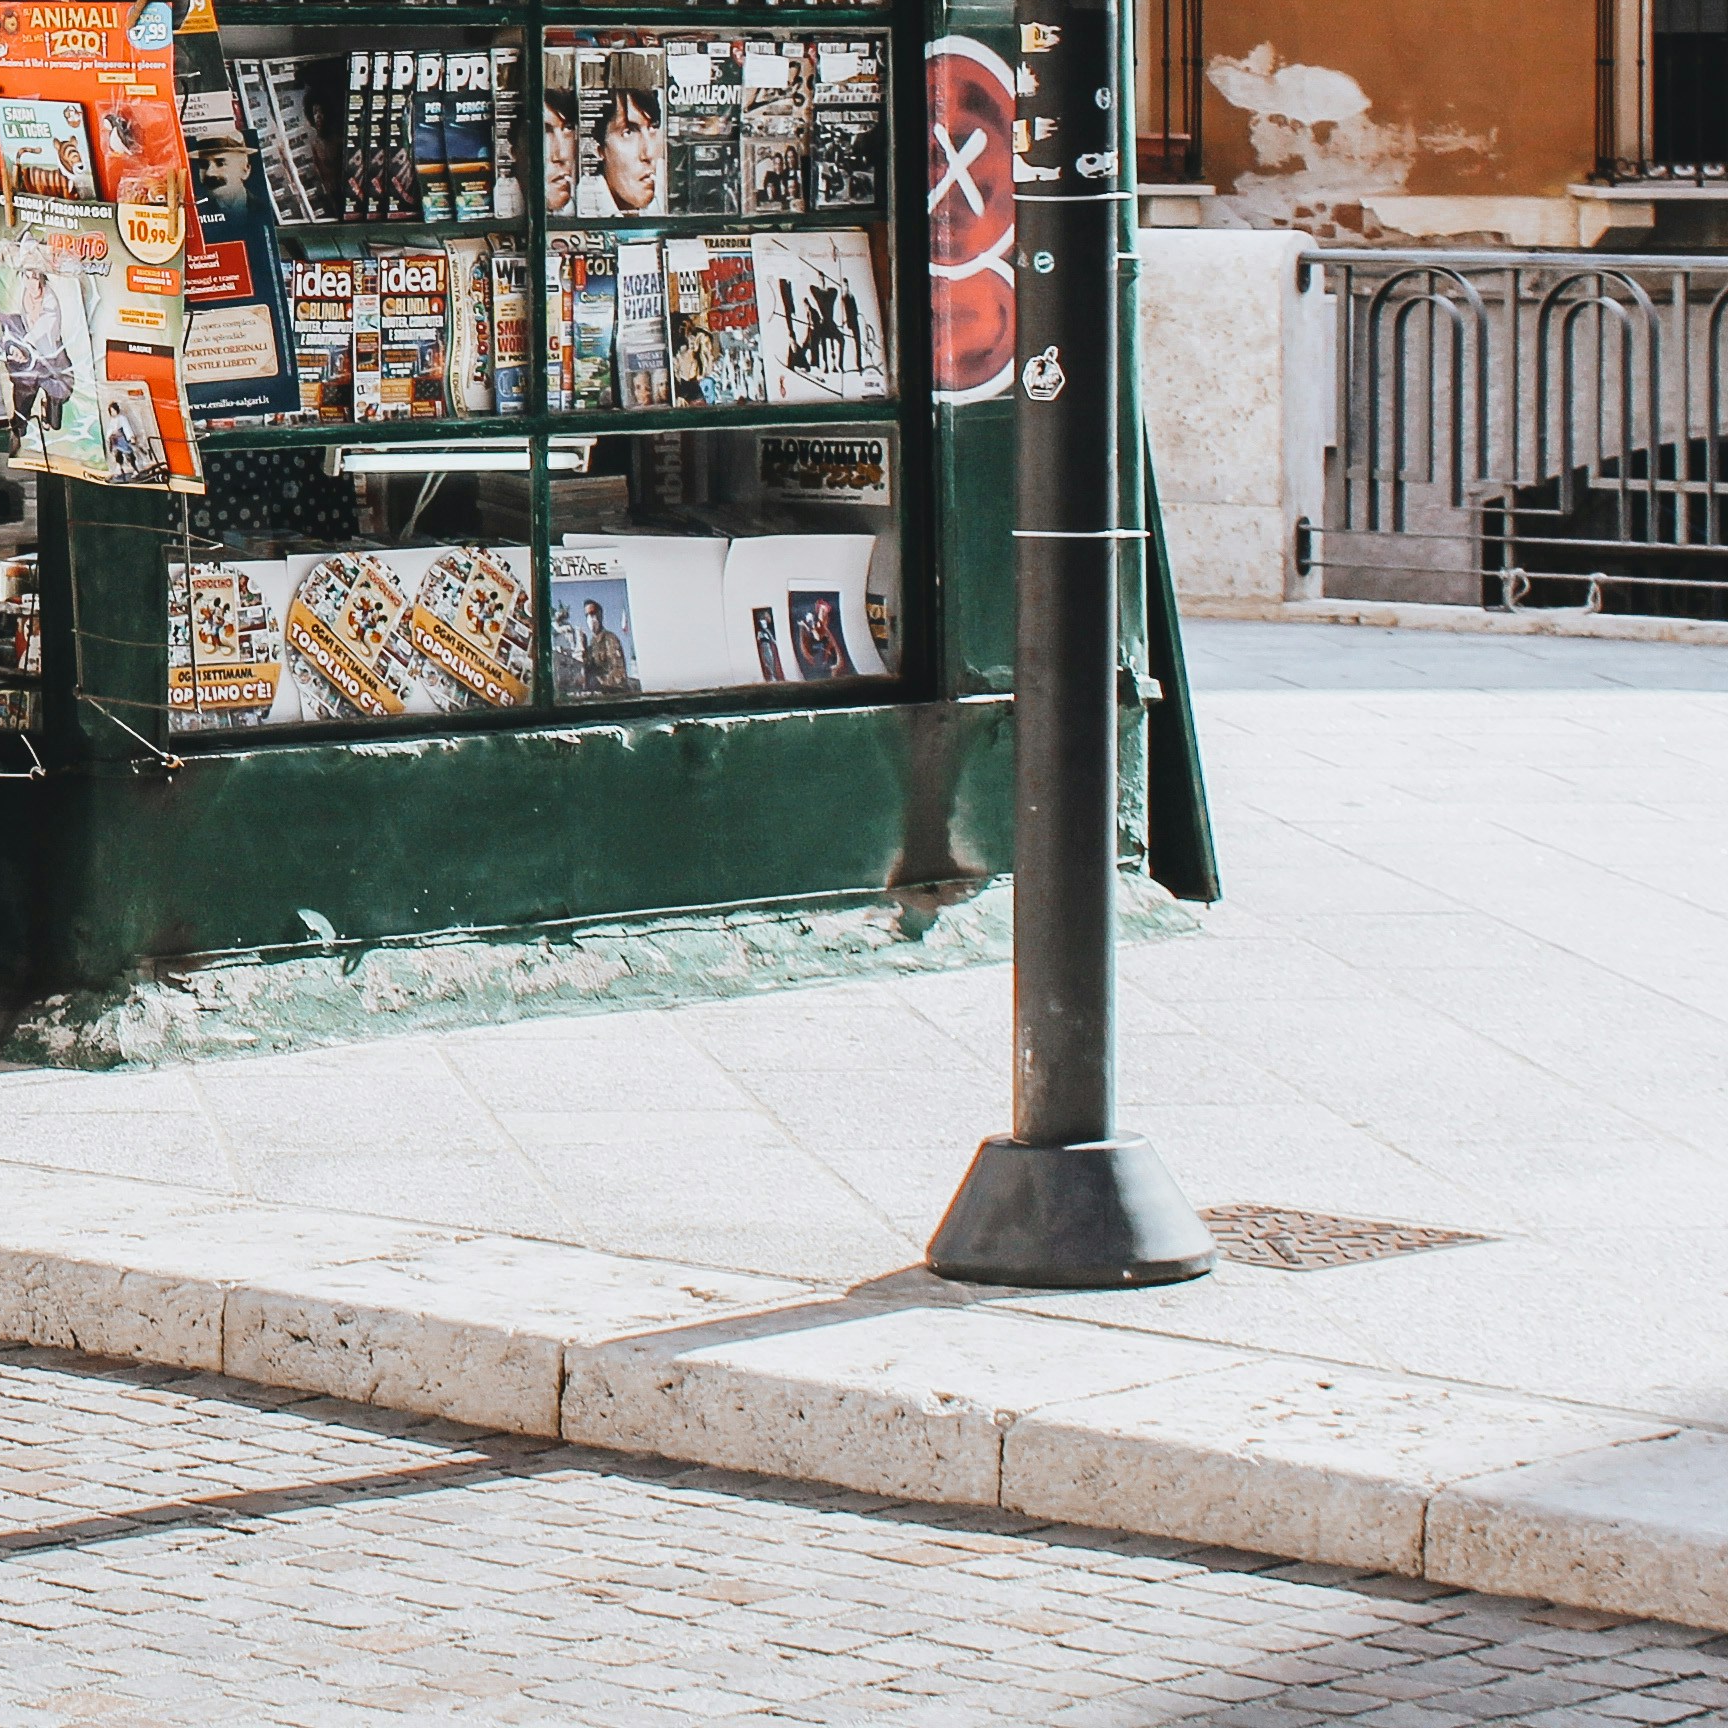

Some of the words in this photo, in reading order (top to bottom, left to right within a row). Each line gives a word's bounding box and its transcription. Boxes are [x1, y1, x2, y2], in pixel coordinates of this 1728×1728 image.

[30, 7, 119, 29] ANIMALI
[50, 30, 102, 52] ZOO
[50, 200, 113, 219] PERSONAGGI
[295, 258, 351, 298] idea
[381, 256, 445, 295] idea!
[308, 301, 345, 320] BLINDA
[394, 297, 430, 316] BLINDA
[222, 356, 258, 369] LIBERTY
[311, 623, 334, 650] OGNI
[432, 624, 456, 647] OGNI
[290, 622, 360, 694] TOPOLINO
[414, 626, 486, 689] TOPOLINO
